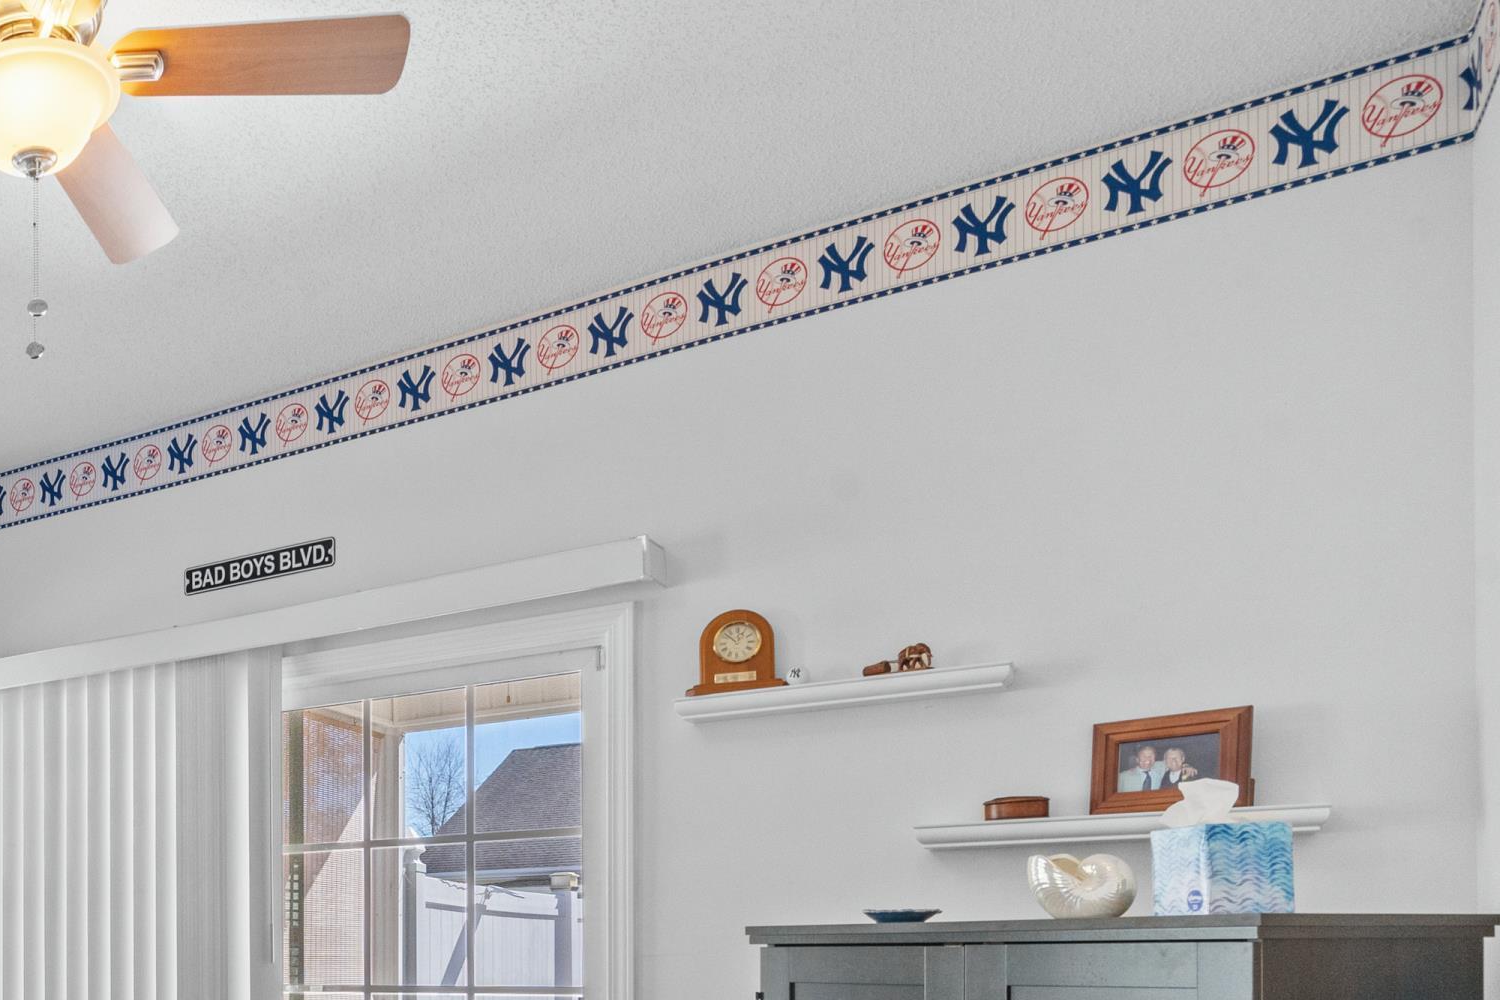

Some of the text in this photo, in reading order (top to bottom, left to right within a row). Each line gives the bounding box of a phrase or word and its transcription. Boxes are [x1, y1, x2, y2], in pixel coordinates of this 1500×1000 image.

[757, 278, 806, 306] Yankees
[885, 242, 940, 271] Yankees
[1028, 200, 1088, 233] Yankees
[1187, 153, 1254, 189] Yankees
[1366, 101, 1442, 139] Yankees
[191, 544, 329, 589] BAD BOYS BLVD.
